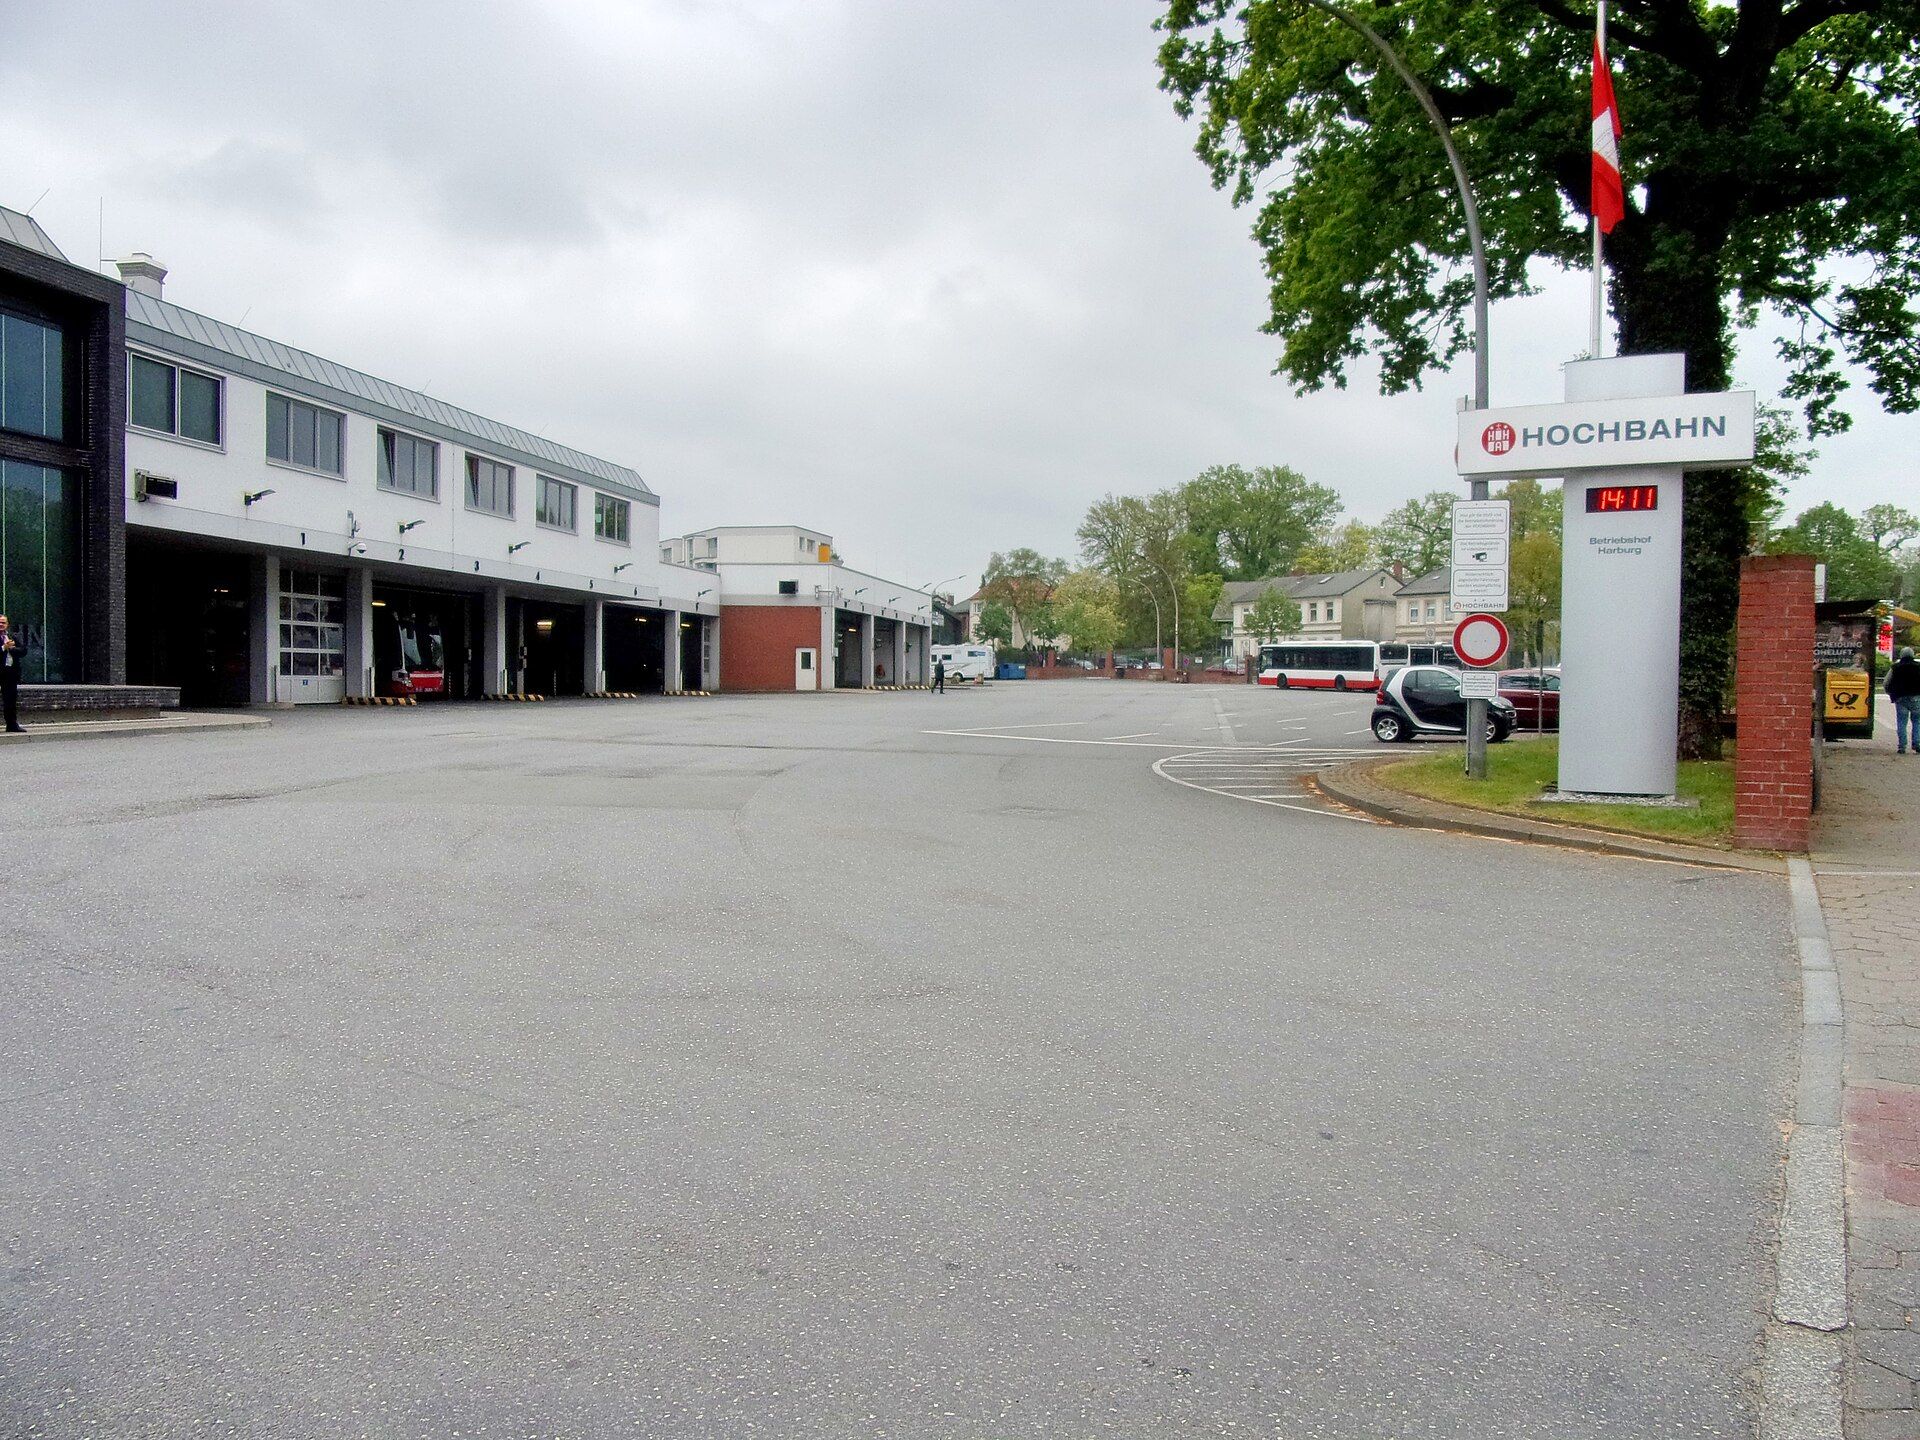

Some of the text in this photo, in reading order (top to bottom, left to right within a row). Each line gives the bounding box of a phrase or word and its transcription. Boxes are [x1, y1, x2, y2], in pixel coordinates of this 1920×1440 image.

[1522, 415, 1727, 448] HOCHBAHN
[1601, 488, 1653, 510] 14:11
[300, 532, 306, 546] 1
[1589, 536, 1652, 545] Betriebshof
[398, 549, 405, 561] 2
[1598, 547, 1642, 555] Harburg
[474, 560, 480, 572] 3
